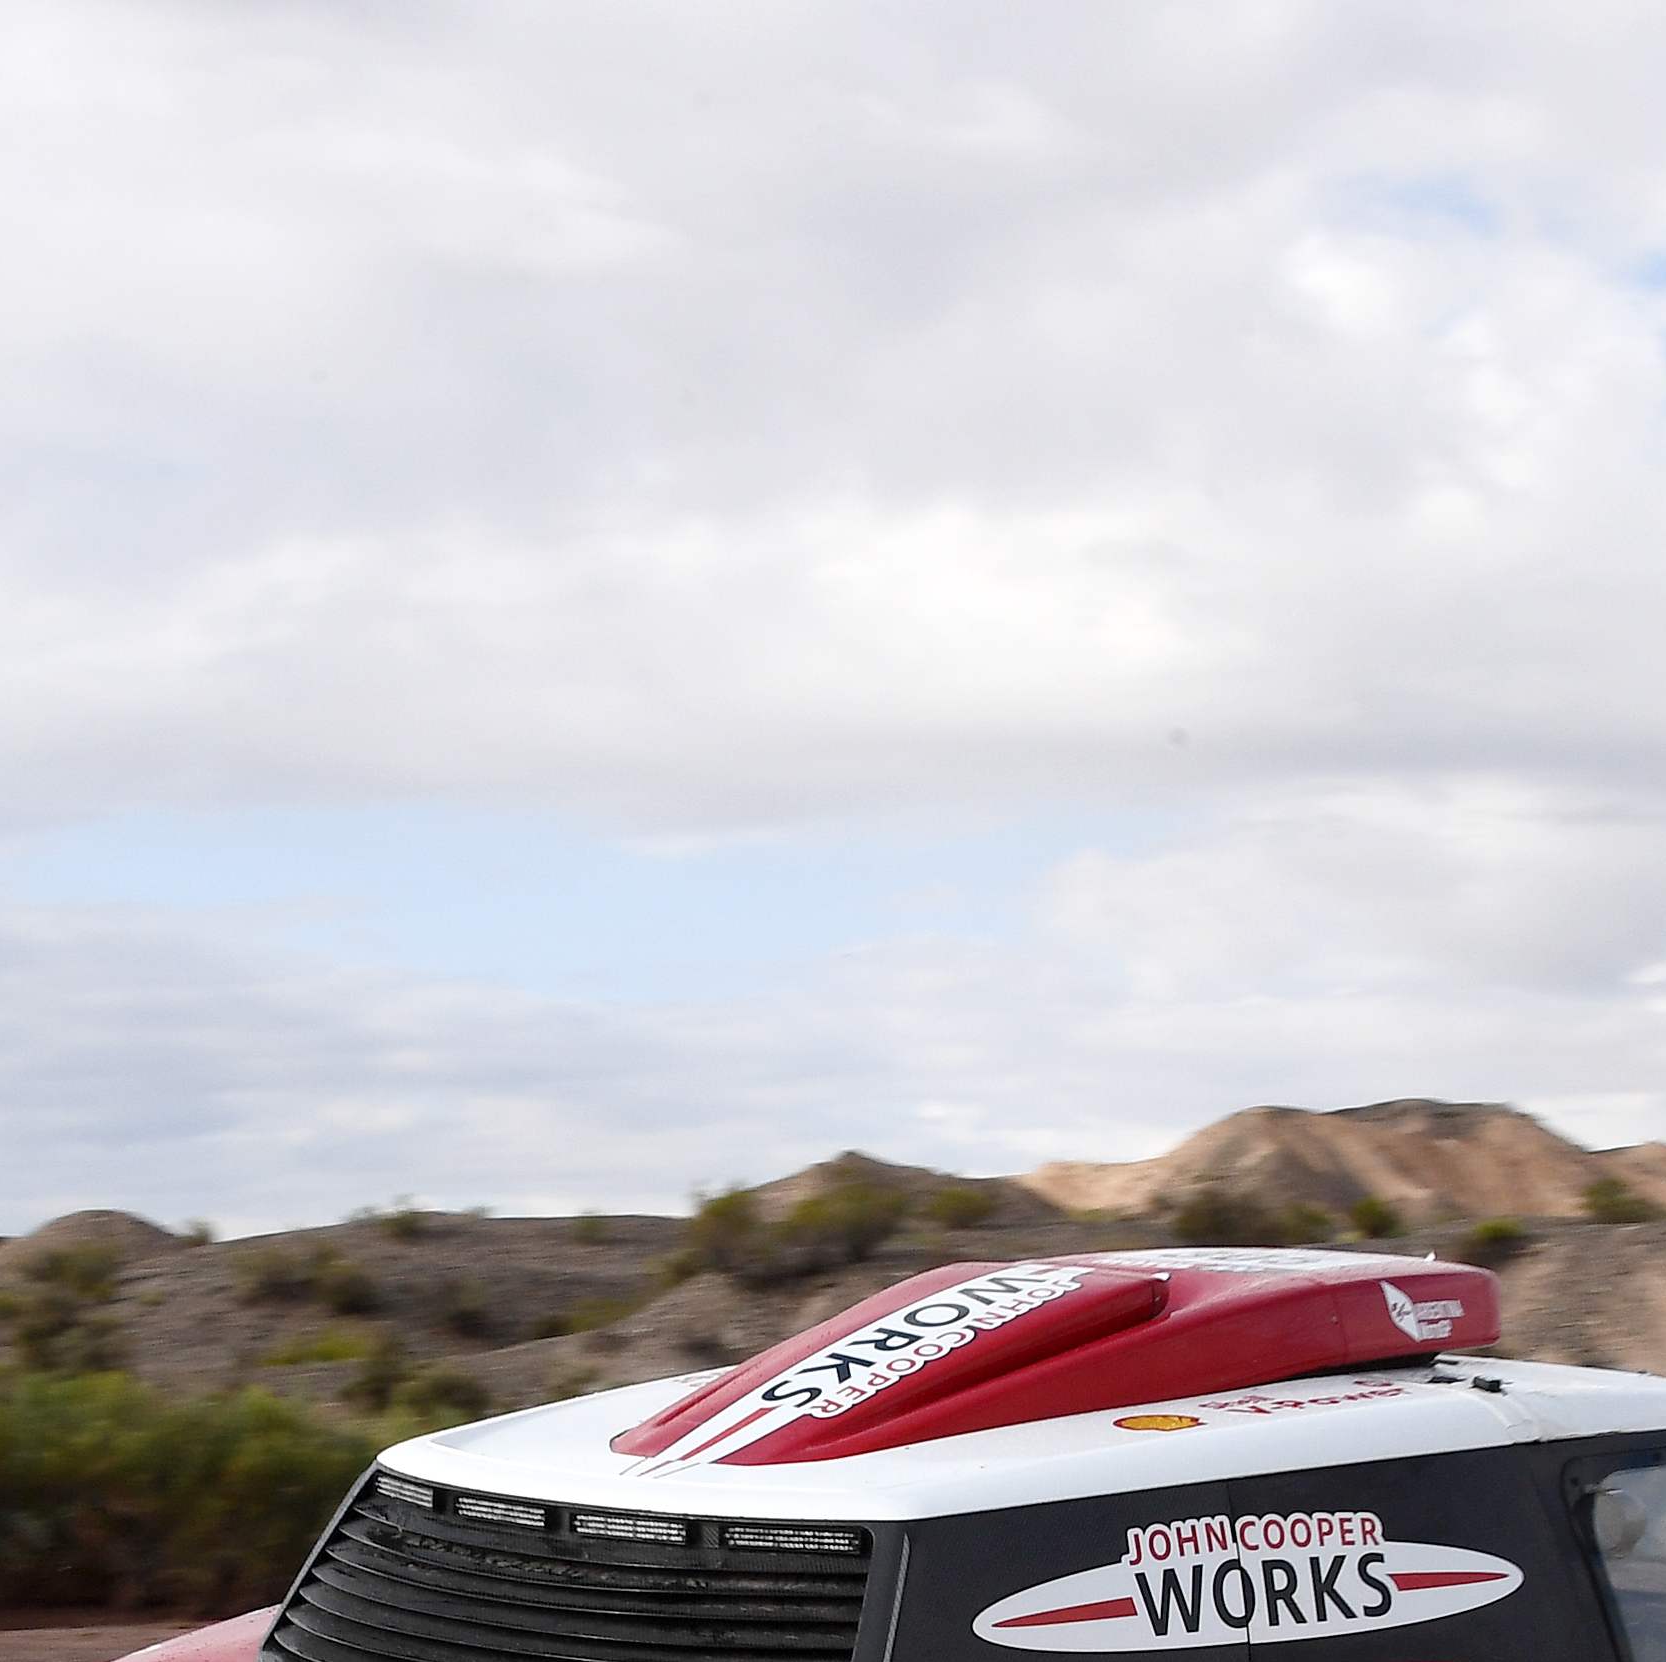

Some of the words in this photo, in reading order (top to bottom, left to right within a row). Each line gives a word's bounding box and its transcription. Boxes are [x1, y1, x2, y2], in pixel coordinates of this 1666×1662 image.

[761, 1277, 1051, 1409] WORKS
[971, 1280, 1079, 1329] JOHN
[812, 1331, 967, 1414] COOPER
[1129, 1521, 1228, 1565] JOHN
[1239, 1517, 1380, 1550] COOPER
[1135, 1552, 1393, 1637] WORKS
